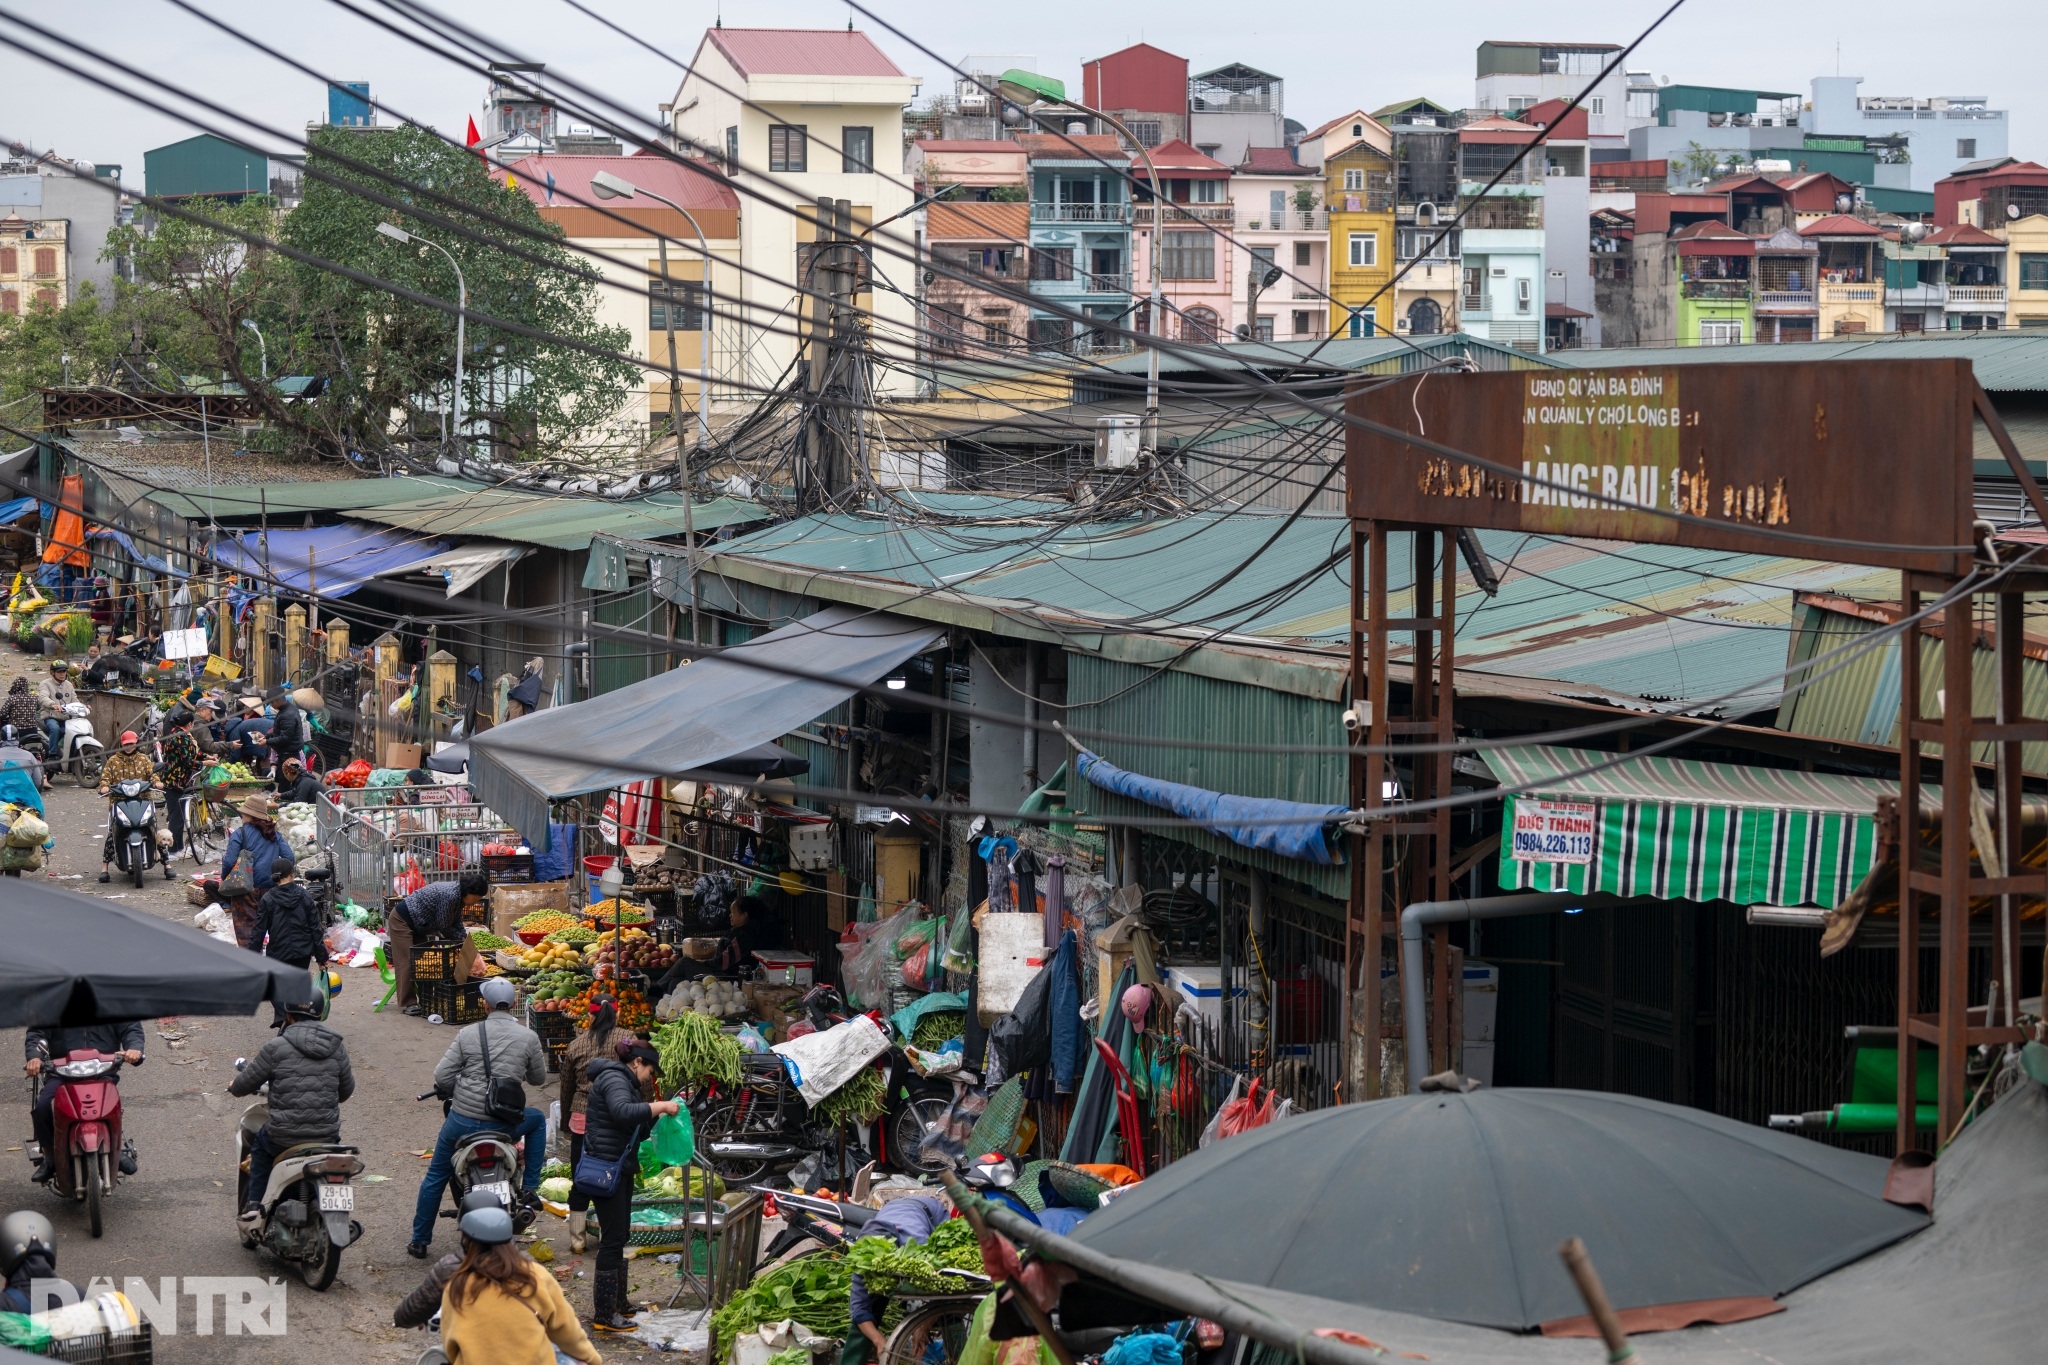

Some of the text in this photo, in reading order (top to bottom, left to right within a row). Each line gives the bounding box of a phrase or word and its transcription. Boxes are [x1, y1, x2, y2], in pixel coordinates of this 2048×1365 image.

[1531, 379, 1565, 397] UBND
[1609, 378, 1627, 396] BA
[1630, 371, 1663, 396] ĐÌNH
[1598, 405, 1625, 430] CHỢ
[1627, 405, 1667, 427] LONG
[1601, 465, 1658, 511] RAU
[1518, 813, 1591, 833] ĐỨC THÀNH
[1515, 832, 1591, 855] 0984.226.113
[324, 1187, 349, 1197] 29-C1
[322, 1199, 353, 1209] 504.05
